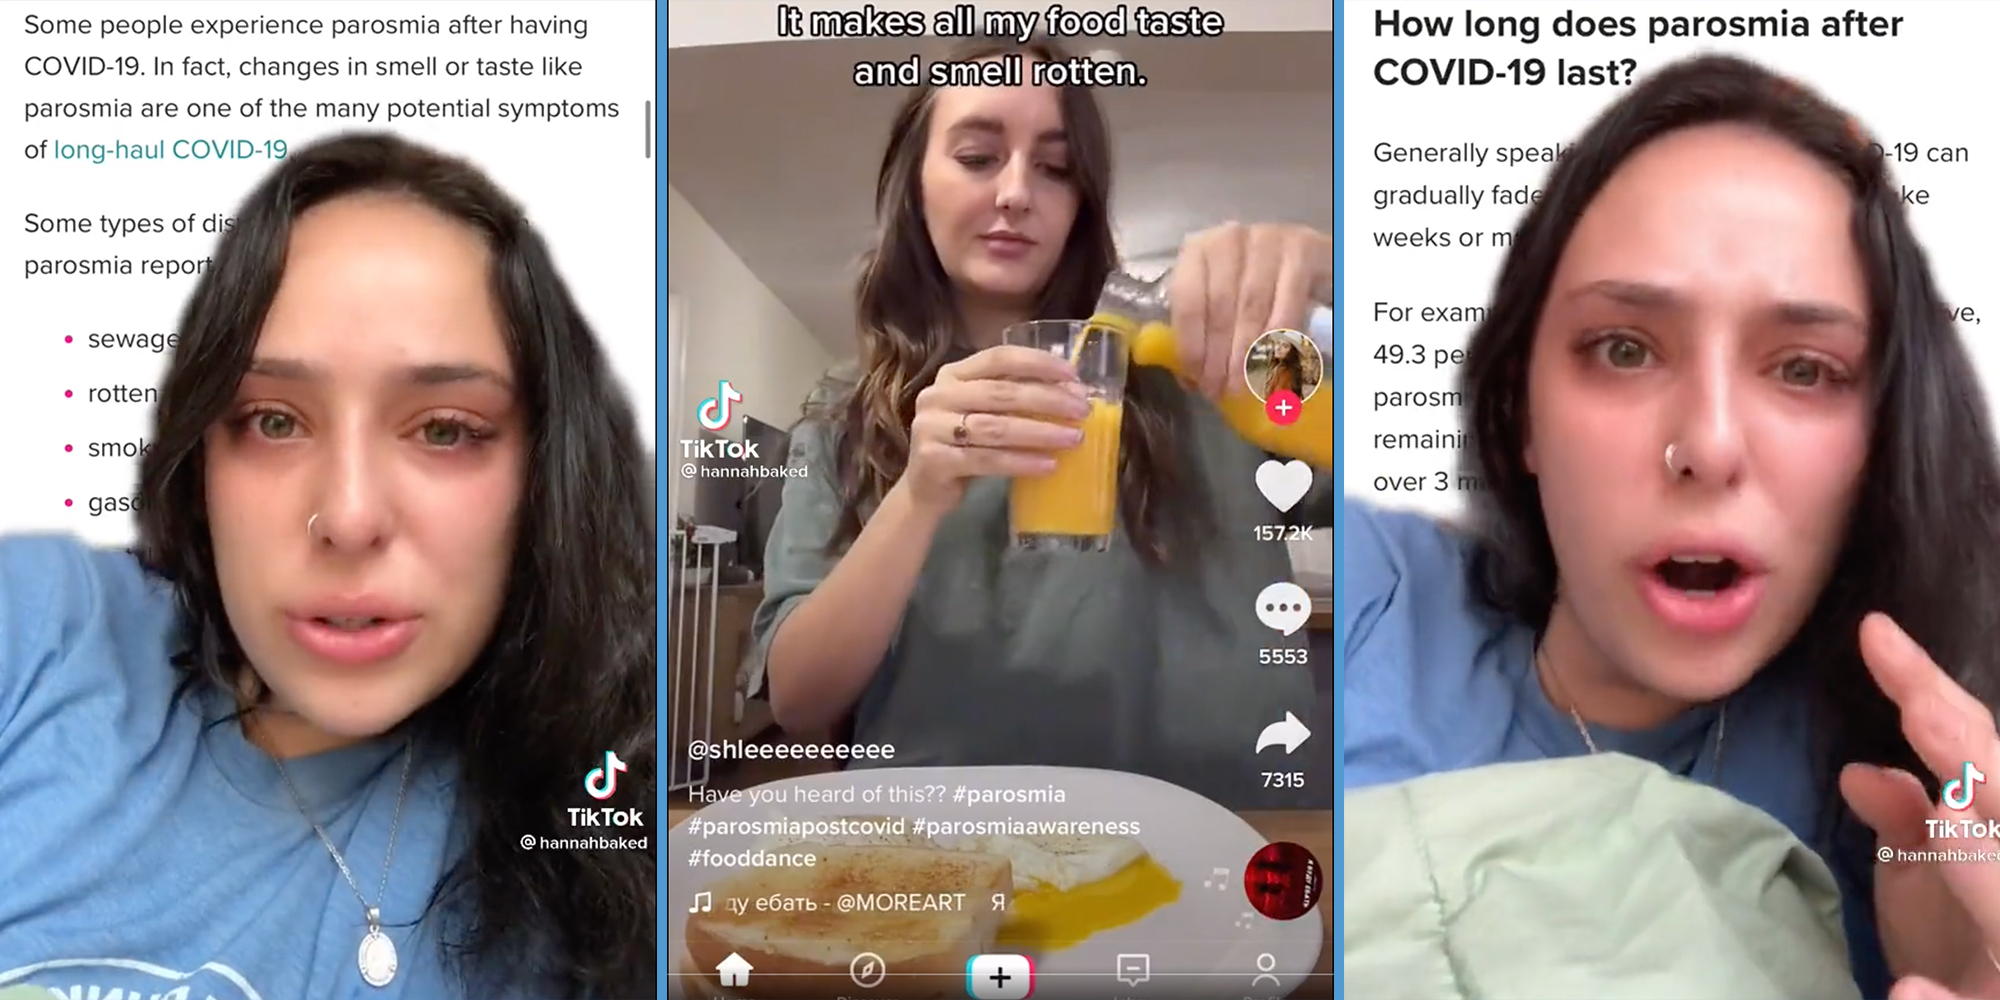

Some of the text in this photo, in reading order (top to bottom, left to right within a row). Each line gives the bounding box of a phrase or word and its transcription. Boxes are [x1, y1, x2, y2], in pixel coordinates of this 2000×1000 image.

[24, 14, 588, 40] Some people experience parosmia after having
[1373, 8, 1904, 45] How long does parosmia after
[24, 55, 583, 82] COVID-19. In fact, changes in smell or taste like
[1373, 57, 1637, 86] COVID-19 last?
[25, 97, 620, 123] parosmia are one of the many potential symptoms
[24, 139, 288, 165] of long-haul COVID-19
[1373, 141, 1489, 168] Generally
[1926, 147, 1969, 163] can
[1373, 184, 1485, 210] gradually
[24, 212, 92, 234] Some
[99, 214, 165, 238] types
[171, 212, 197, 234] of
[1373, 226, 1452, 248] weeks
[1458, 231, 1484, 248] or
[25, 255, 132, 280] parosmia
[1374, 301, 1492, 323] For exam
[88, 332, 181, 354] sewage
[1373, 343, 1426, 365] 49.3
[89, 384, 158, 403] rotten
[1373, 475, 1427, 492] over
[1434, 470, 1449, 492] 3
